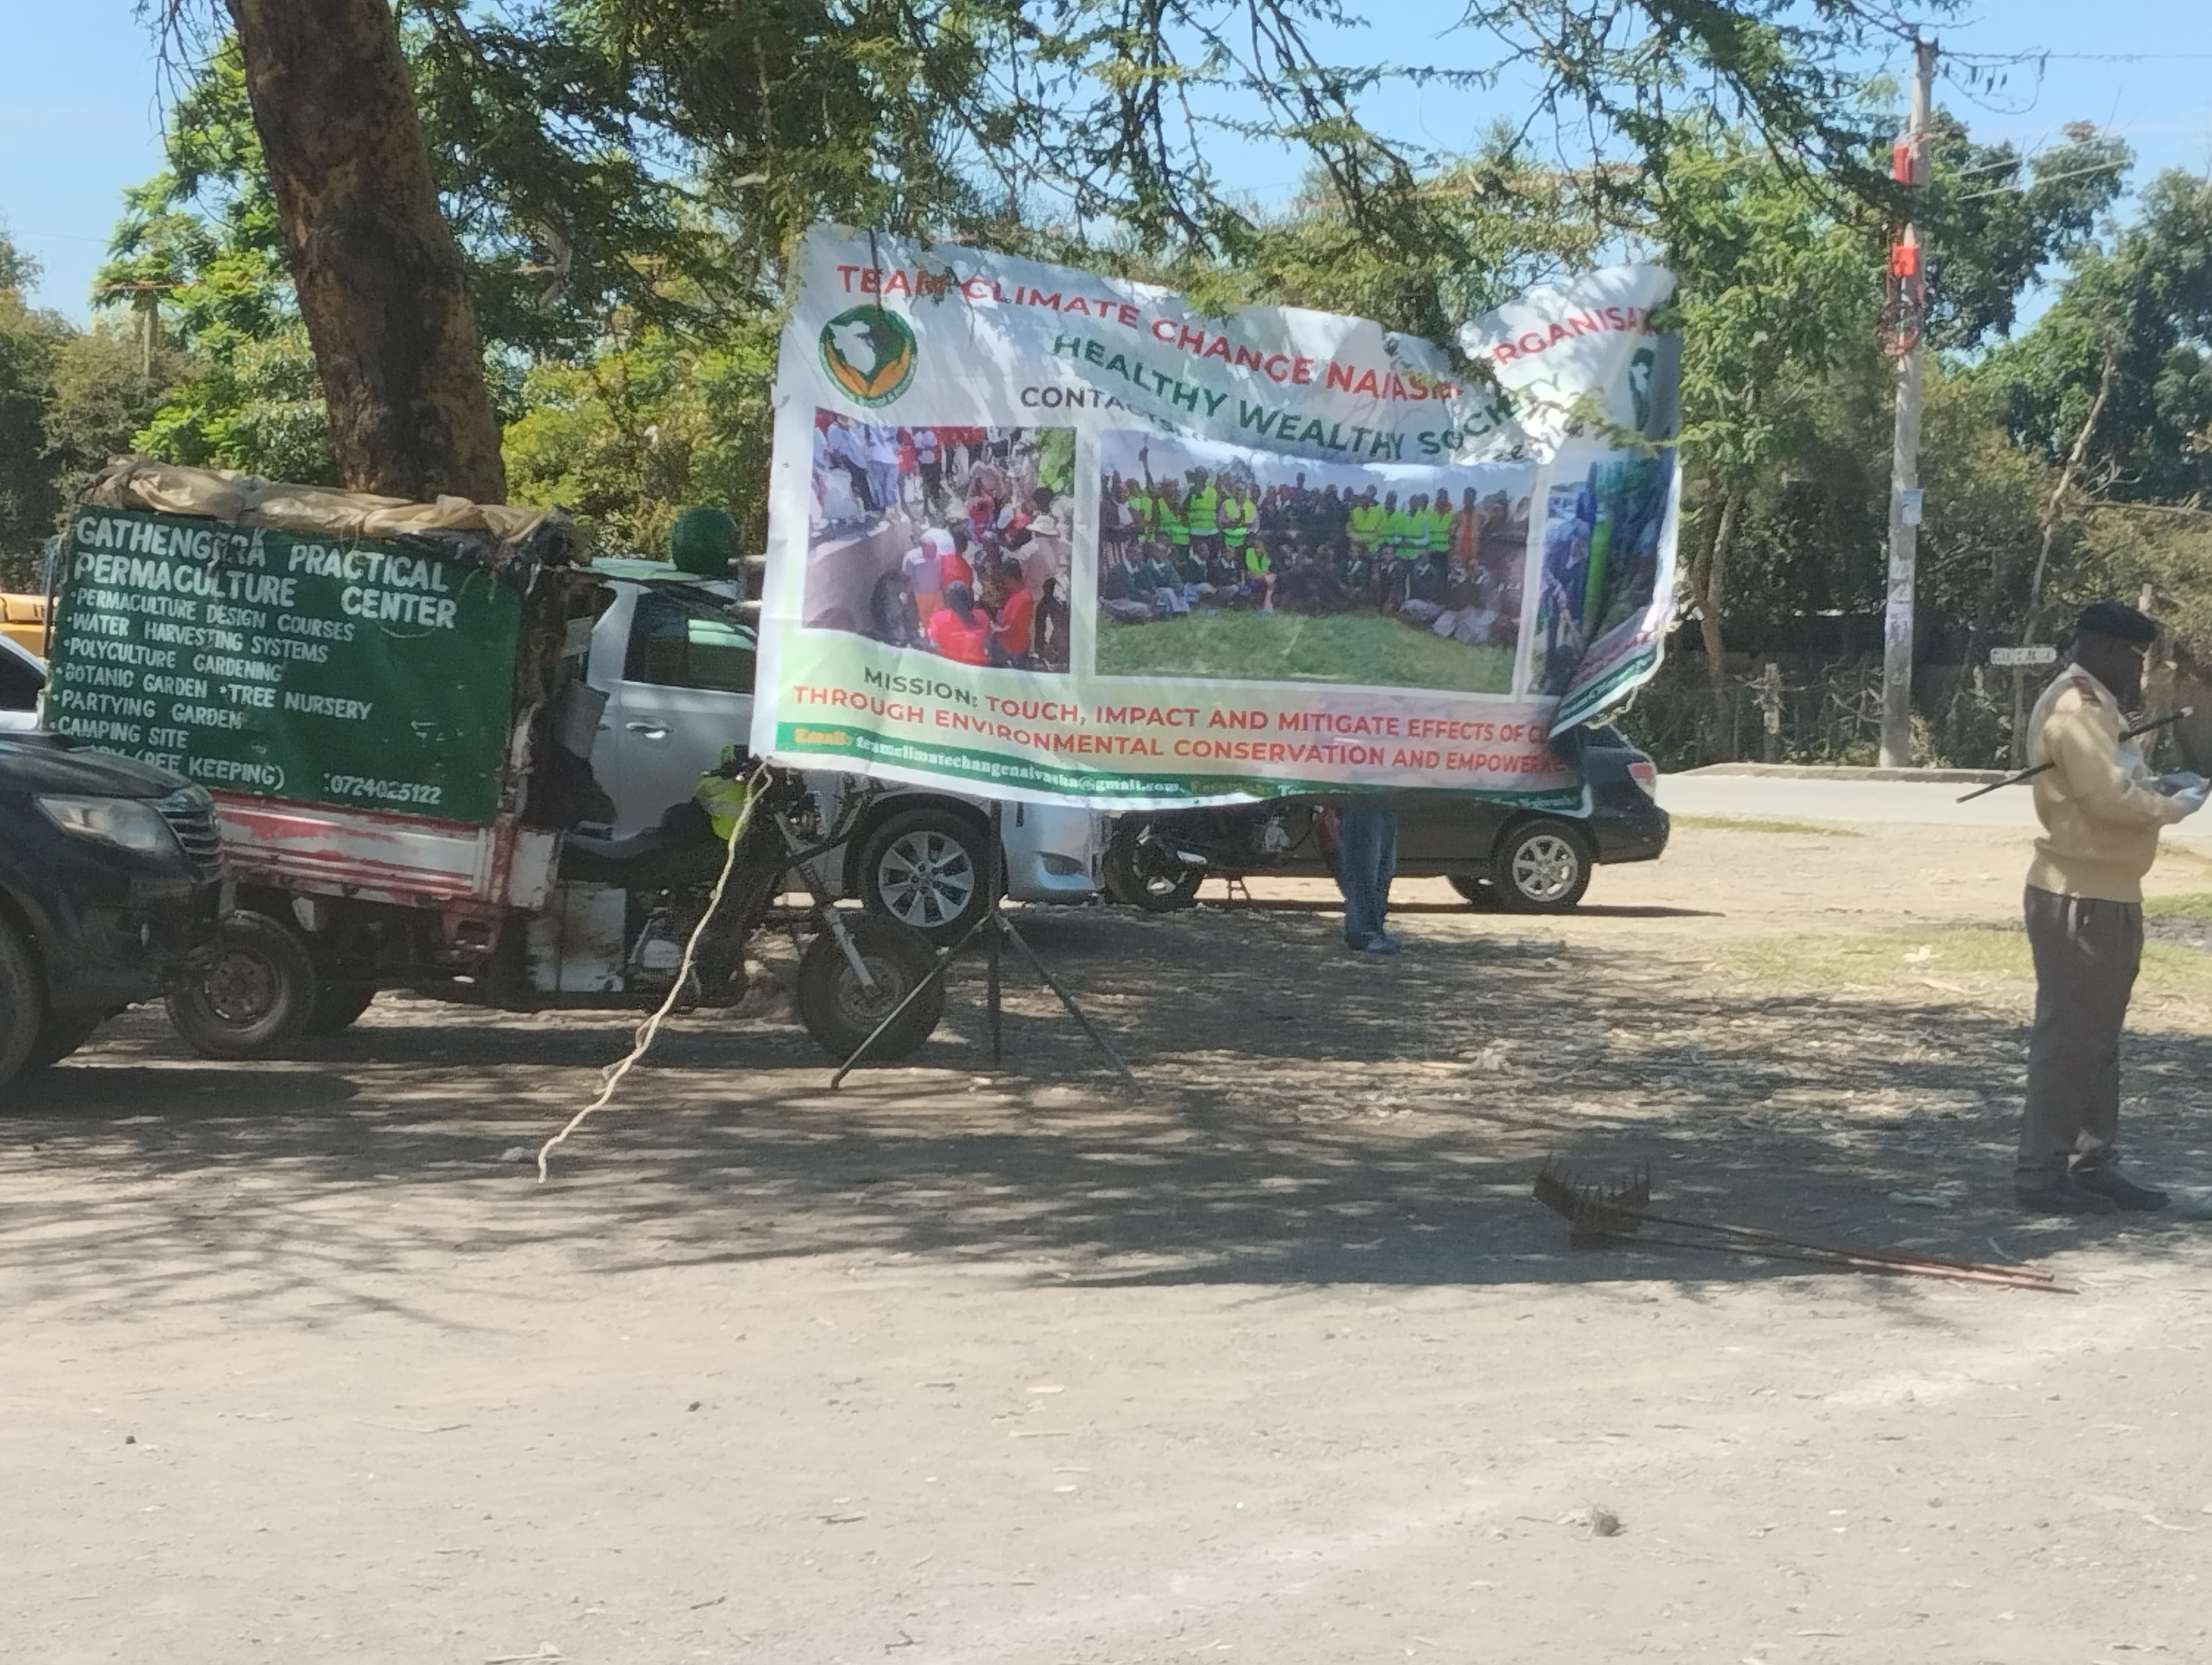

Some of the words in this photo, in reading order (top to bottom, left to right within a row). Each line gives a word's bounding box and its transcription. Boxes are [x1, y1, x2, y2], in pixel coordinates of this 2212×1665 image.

[960, 275, 1141, 329] CLIMATE
[1152, 319, 1314, 385] CHANGE
[1053, 334, 1228, 417] HEALTHY
[1240, 400, 1404, 461] WEALTHY
[74, 552, 298, 607] PERMACULTURE
[341, 586, 457, 629] CENTER
[289, 544, 449, 592] PRACTICAL
[73, 612, 130, 636] WATER
[144, 621, 244, 651] HARVESTING
[251, 636, 329, 663] SYSTEMS
[77, 587, 197, 620] PERMACULTURE
[206, 604, 266, 628] DESIGN
[278, 614, 355, 642] COURSES
[70, 638, 176, 669] POLYCULTURE
[193, 654, 282, 682] GARDENING
[62, 689, 156, 718] PARTYING
[172, 703, 243, 730] GARDEN
[65, 662, 134, 688] BOTANIC
[143, 674, 207, 699] GARDEN
[228, 684, 276, 708] TREE
[284, 692, 373, 720] NURSERY
[864, 667, 978, 708] MISSION:
[986, 696, 1086, 726] TOUCH,
[1096, 706, 1200, 727] IMPACT
[1207, 710, 1268, 730] AND
[1278, 712, 1399, 736] MITIGATE
[1407, 719, 1495, 741] EFFECTS
[1499, 724, 1524, 742] OF
[59, 716, 141, 743] CAMPING
[148, 727, 190, 749] SITE
[794, 685, 924, 723] THROUGH
[935, 710, 1164, 756] ENVIRONMENTAL
[1174, 739, 1384, 765] CONSERVATION
[1392, 749, 1440, 769] AND
[188, 756, 285, 790] KEEPING)
